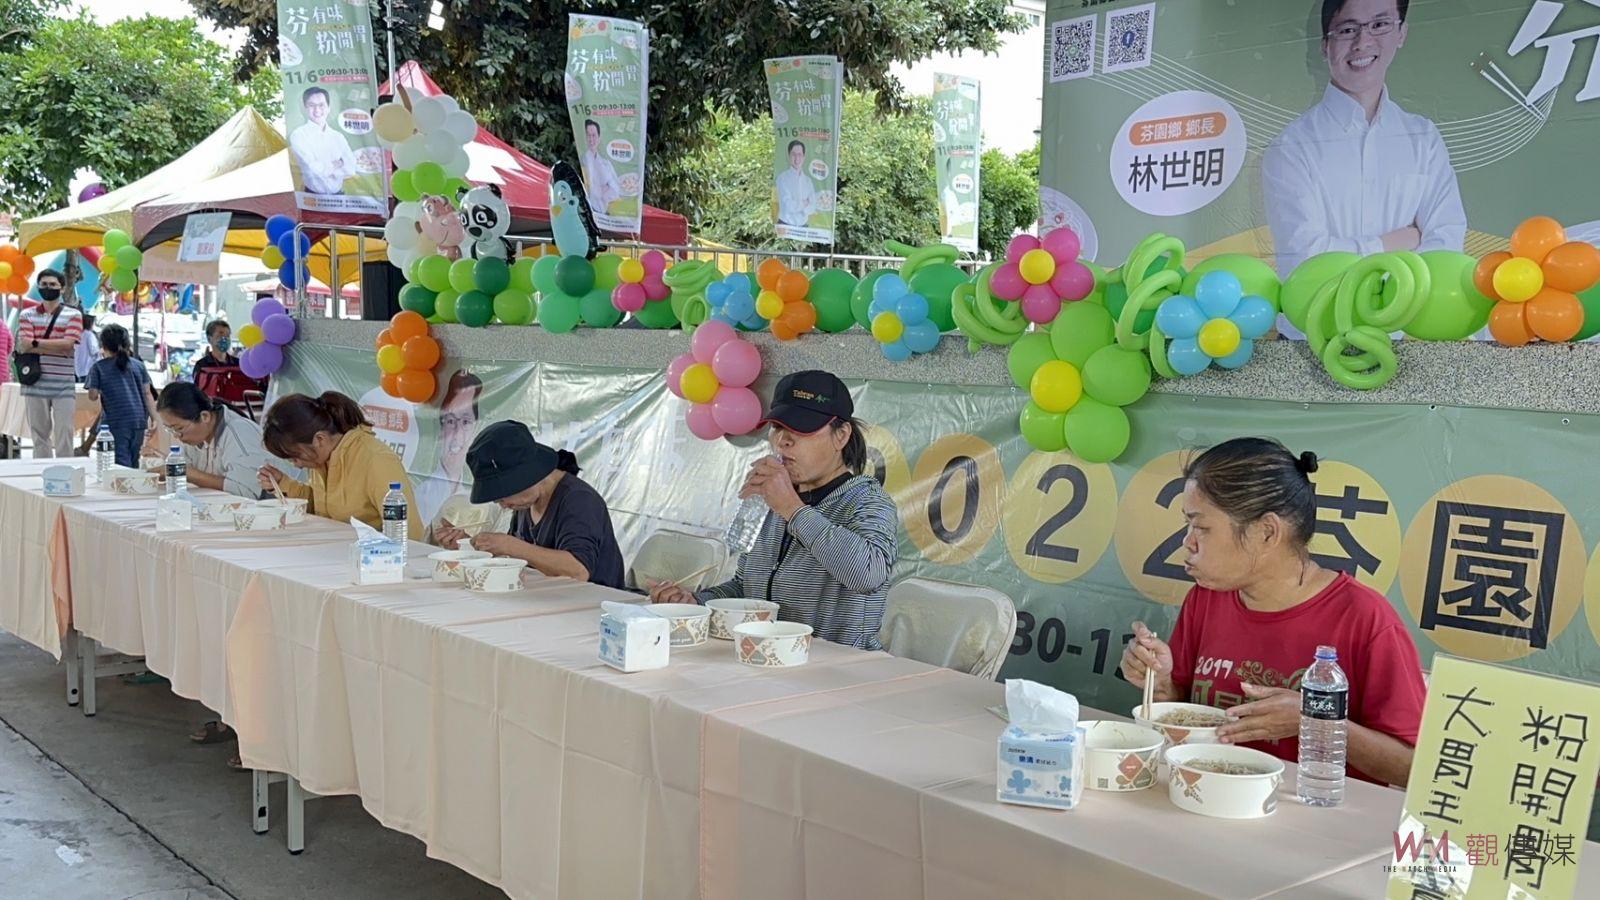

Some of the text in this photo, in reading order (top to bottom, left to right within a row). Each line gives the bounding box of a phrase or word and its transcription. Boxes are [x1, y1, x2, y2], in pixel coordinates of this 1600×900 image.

[1140, 117, 1215, 142] 芬園鄉 鄉長
[1128, 148, 1225, 193] 林世明
